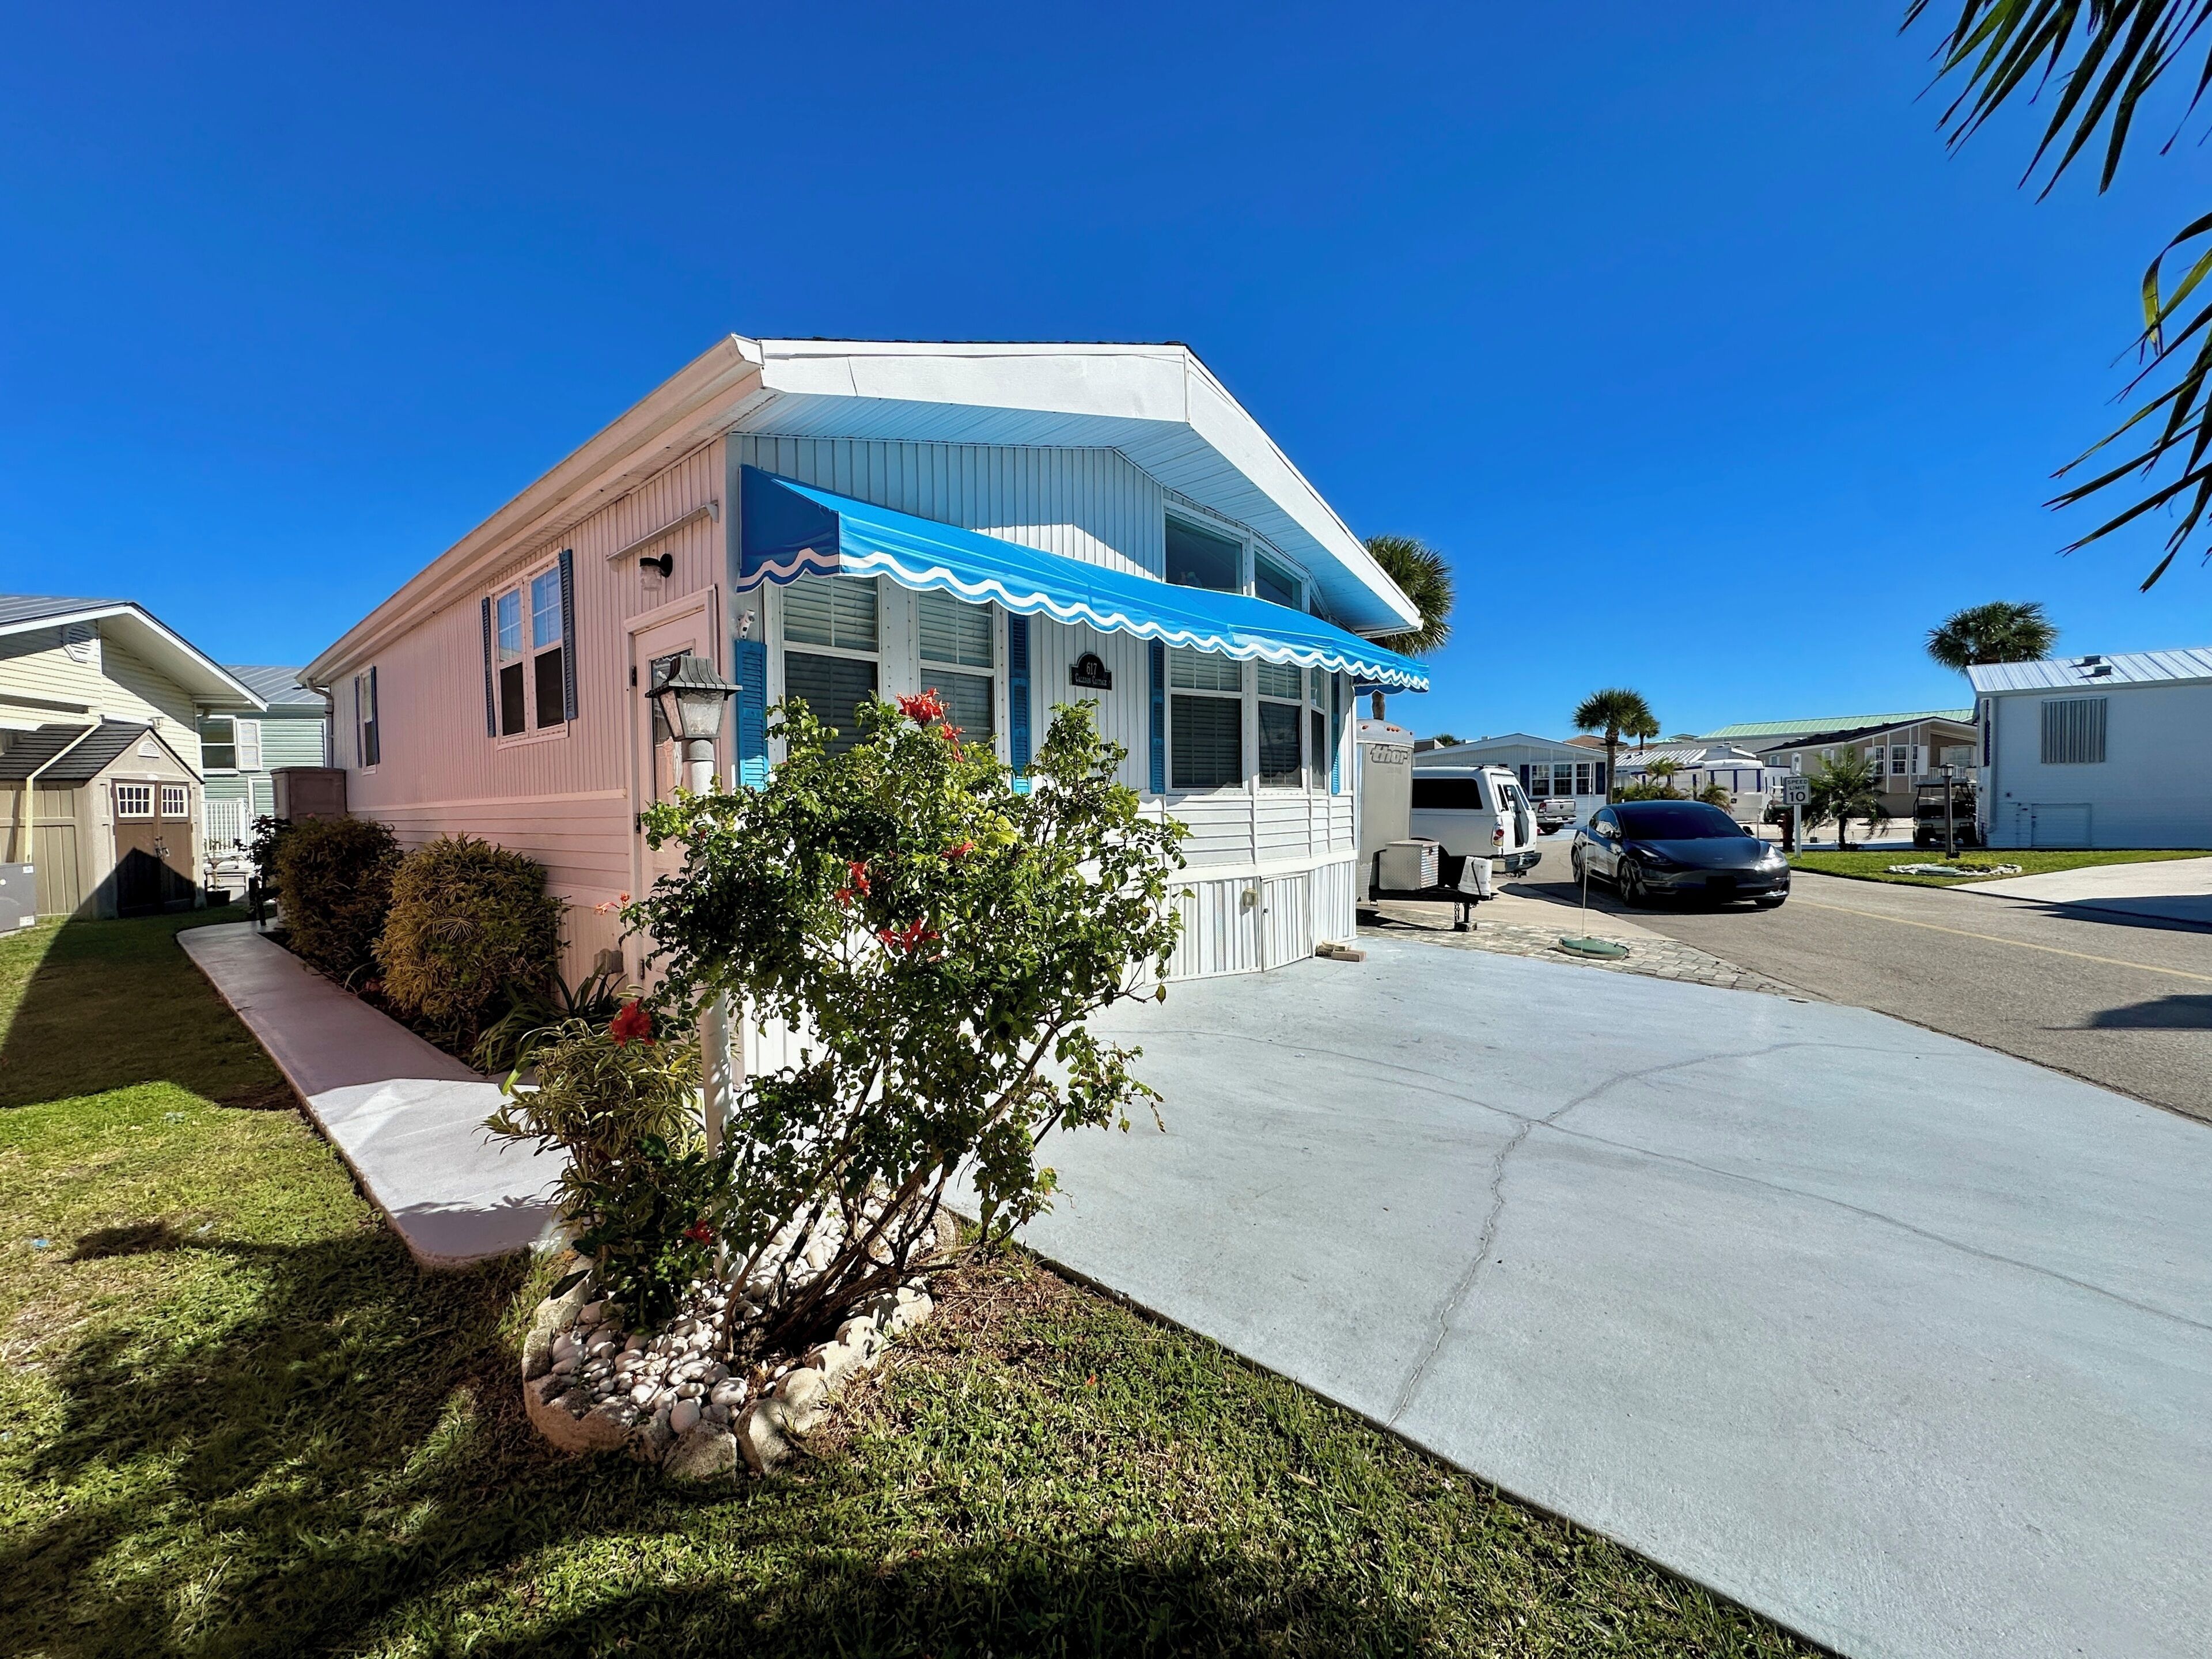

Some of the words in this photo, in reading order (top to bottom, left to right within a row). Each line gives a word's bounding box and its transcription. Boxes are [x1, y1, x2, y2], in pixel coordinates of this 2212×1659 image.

[1086, 662, 1097, 675] 617
[1370, 744, 1408, 764] thor
[1790, 791, 1805, 801] 10
